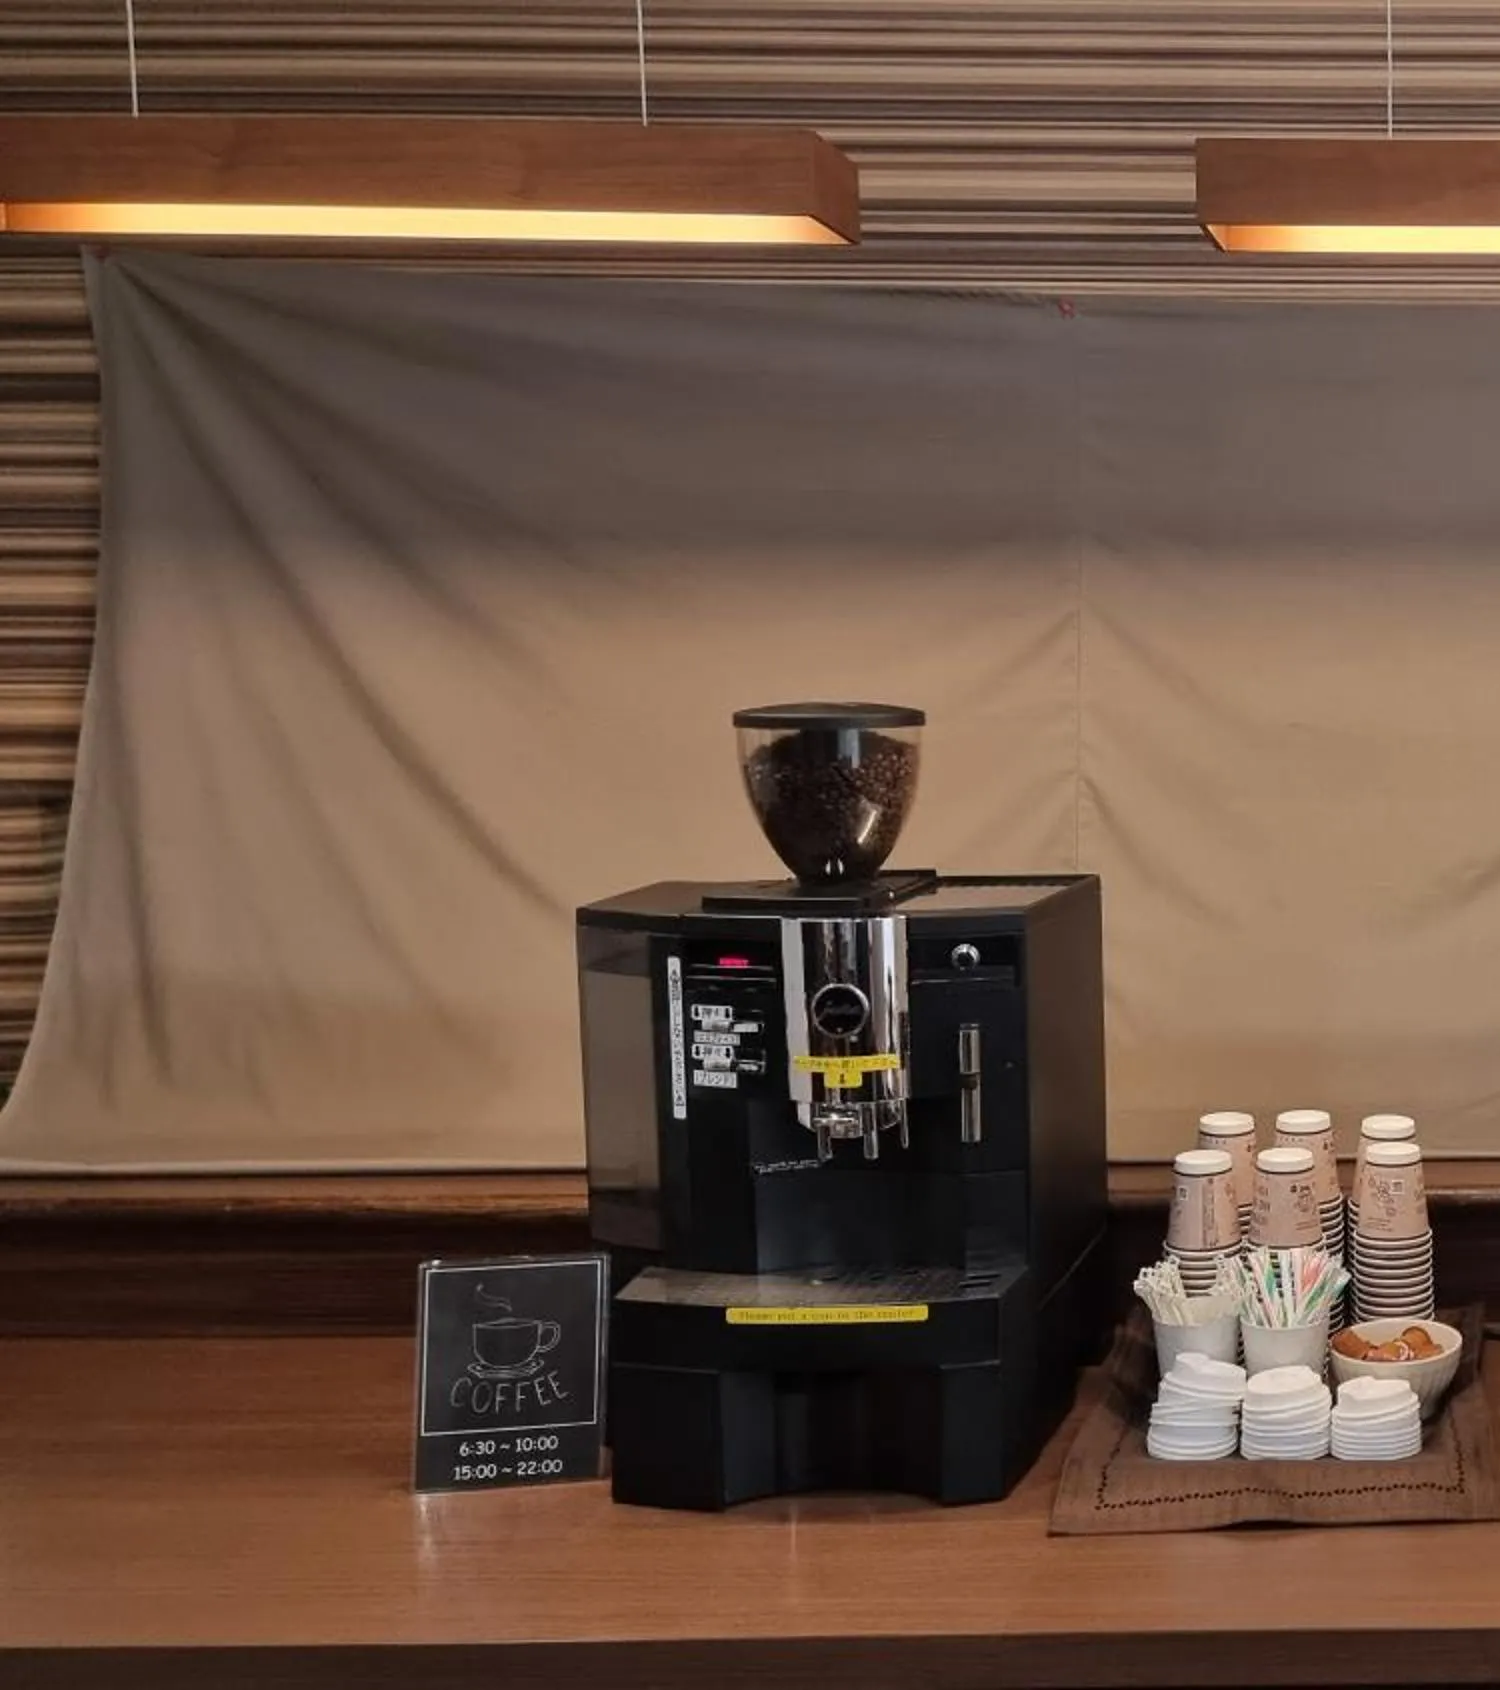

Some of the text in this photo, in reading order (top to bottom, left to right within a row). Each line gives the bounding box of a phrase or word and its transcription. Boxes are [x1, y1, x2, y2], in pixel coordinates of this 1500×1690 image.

[450, 1370, 569, 1414] COFFEE
[458, 1440, 496, 1457] 6:30
[515, 1435, 559, 1452] 10:00
[453, 1463, 497, 1482] 15:00
[517, 1459, 563, 1476] 22:00
